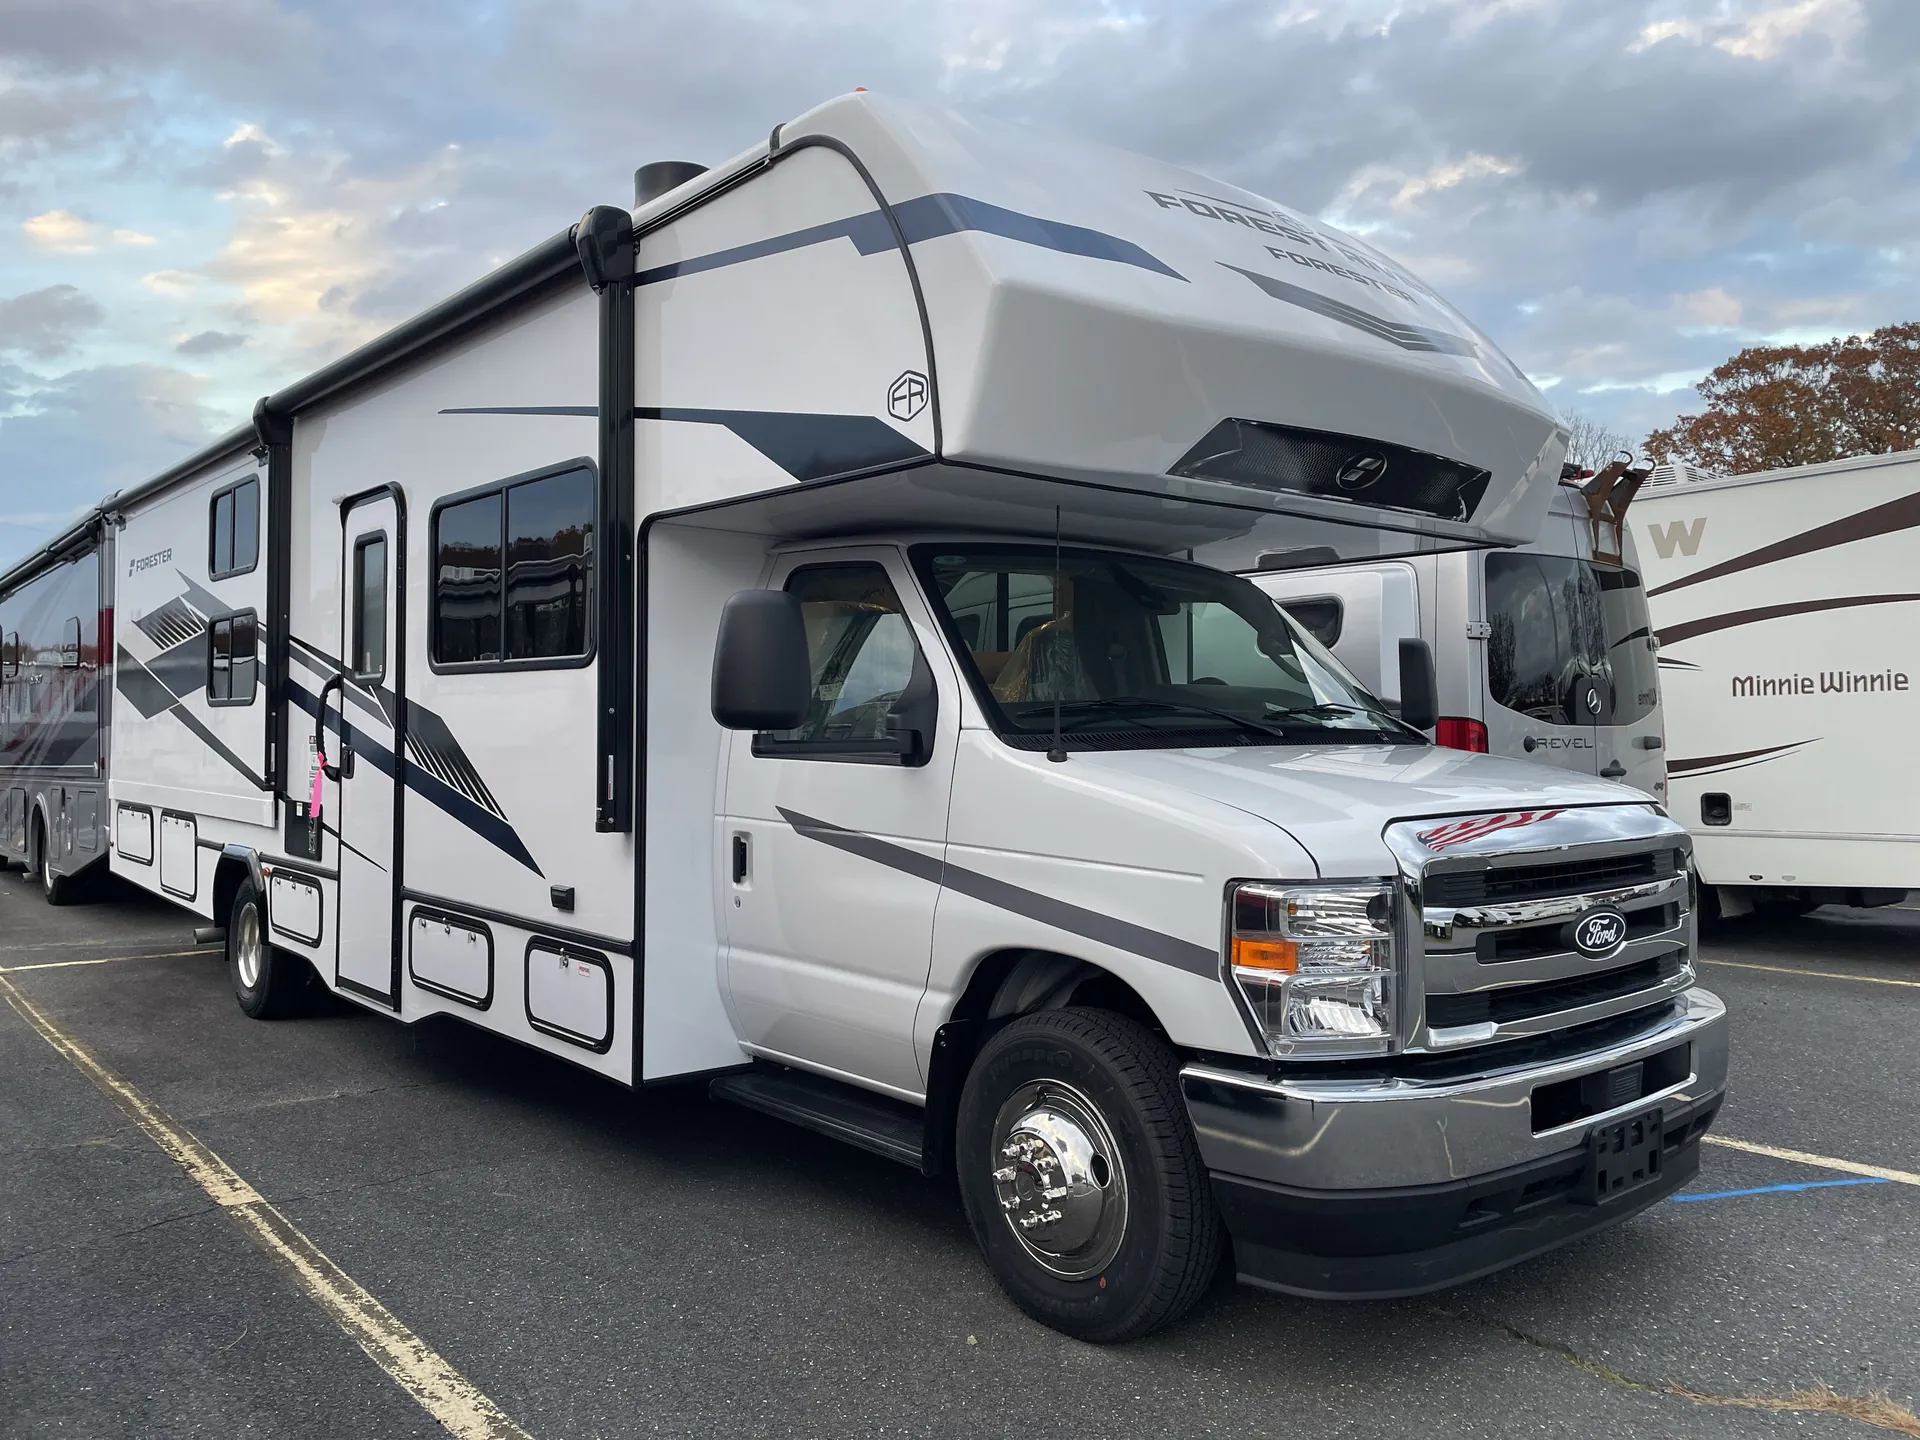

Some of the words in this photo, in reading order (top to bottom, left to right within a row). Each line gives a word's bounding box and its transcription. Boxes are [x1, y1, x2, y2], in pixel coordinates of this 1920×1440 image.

[1142, 189, 1329, 252] FOREST
[1263, 244, 1419, 305] FORESTER
[1647, 517, 1708, 559] W
[135, 547, 172, 572] FORESTER
[1732, 673, 1815, 697] Minnie
[1820, 668, 1909, 693] Winnie
[1586, 918, 1617, 946] Ford
